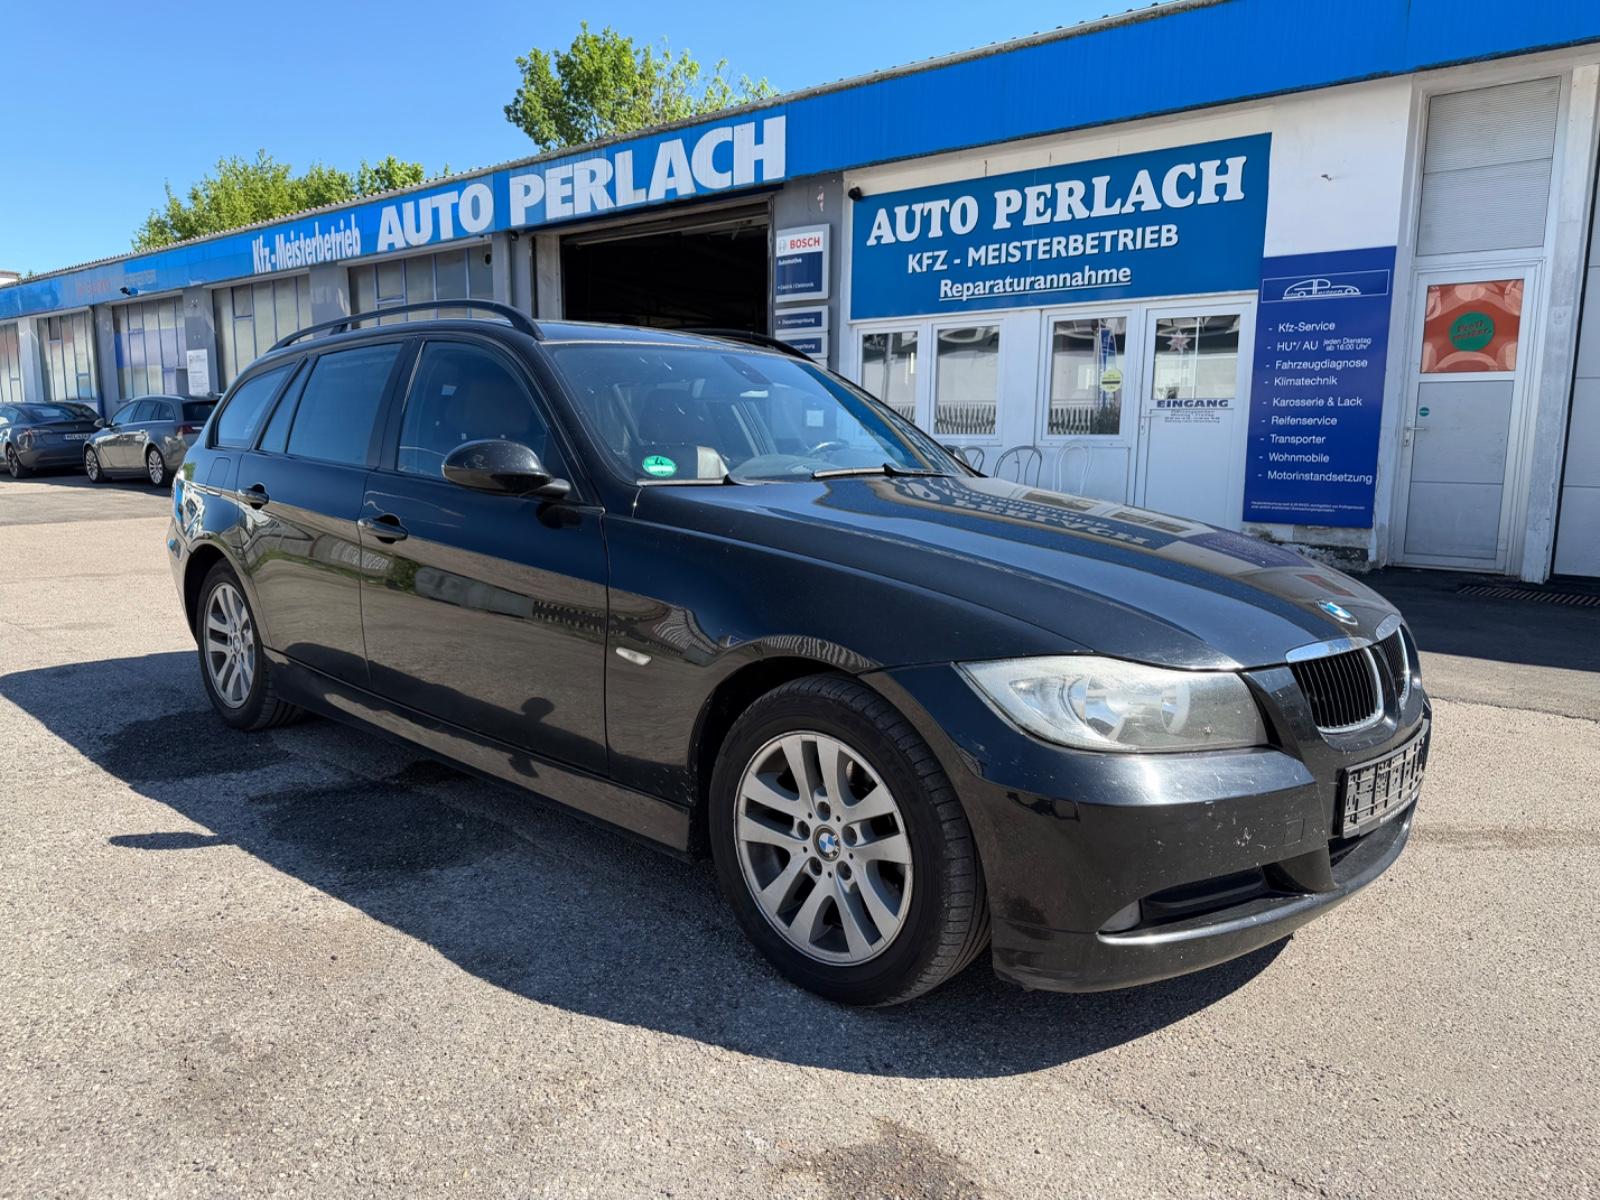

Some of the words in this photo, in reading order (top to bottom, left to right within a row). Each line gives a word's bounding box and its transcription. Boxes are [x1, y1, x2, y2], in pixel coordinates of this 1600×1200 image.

[252, 214, 361, 274] Kfz-Meisterbetrieb
[377, 183, 494, 252] AUTO
[509, 115, 786, 226] PERLACH
[866, 196, 978, 246] AUTO
[993, 156, 1247, 230] PERLACH
[789, 237, 820, 249] BOSCH
[907, 249, 947, 273] KFZ
[967, 224, 1179, 267] MEISTERBETRIEB
[939, 265, 1131, 301] Reparaturannahme
[1278, 321, 1335, 333] Kfz-Service
[1302, 340, 1318, 351] AU
[1275, 359, 1368, 371] Fahrzeugdiagnose
[1274, 376, 1338, 386] Klimatechnik
[1157, 400, 1229, 408] EINGANG
[1272, 397, 1324, 407] Karosserie
[1327, 397, 1334, 406] &
[1338, 397, 1362, 406] Lack
[1271, 416, 1338, 426] Reifenservice
[1270, 434, 1326, 445] Transporter
[1269, 452, 1330, 463] Wohnmobile
[1267, 470, 1373, 484] Motorinstandsetzung
